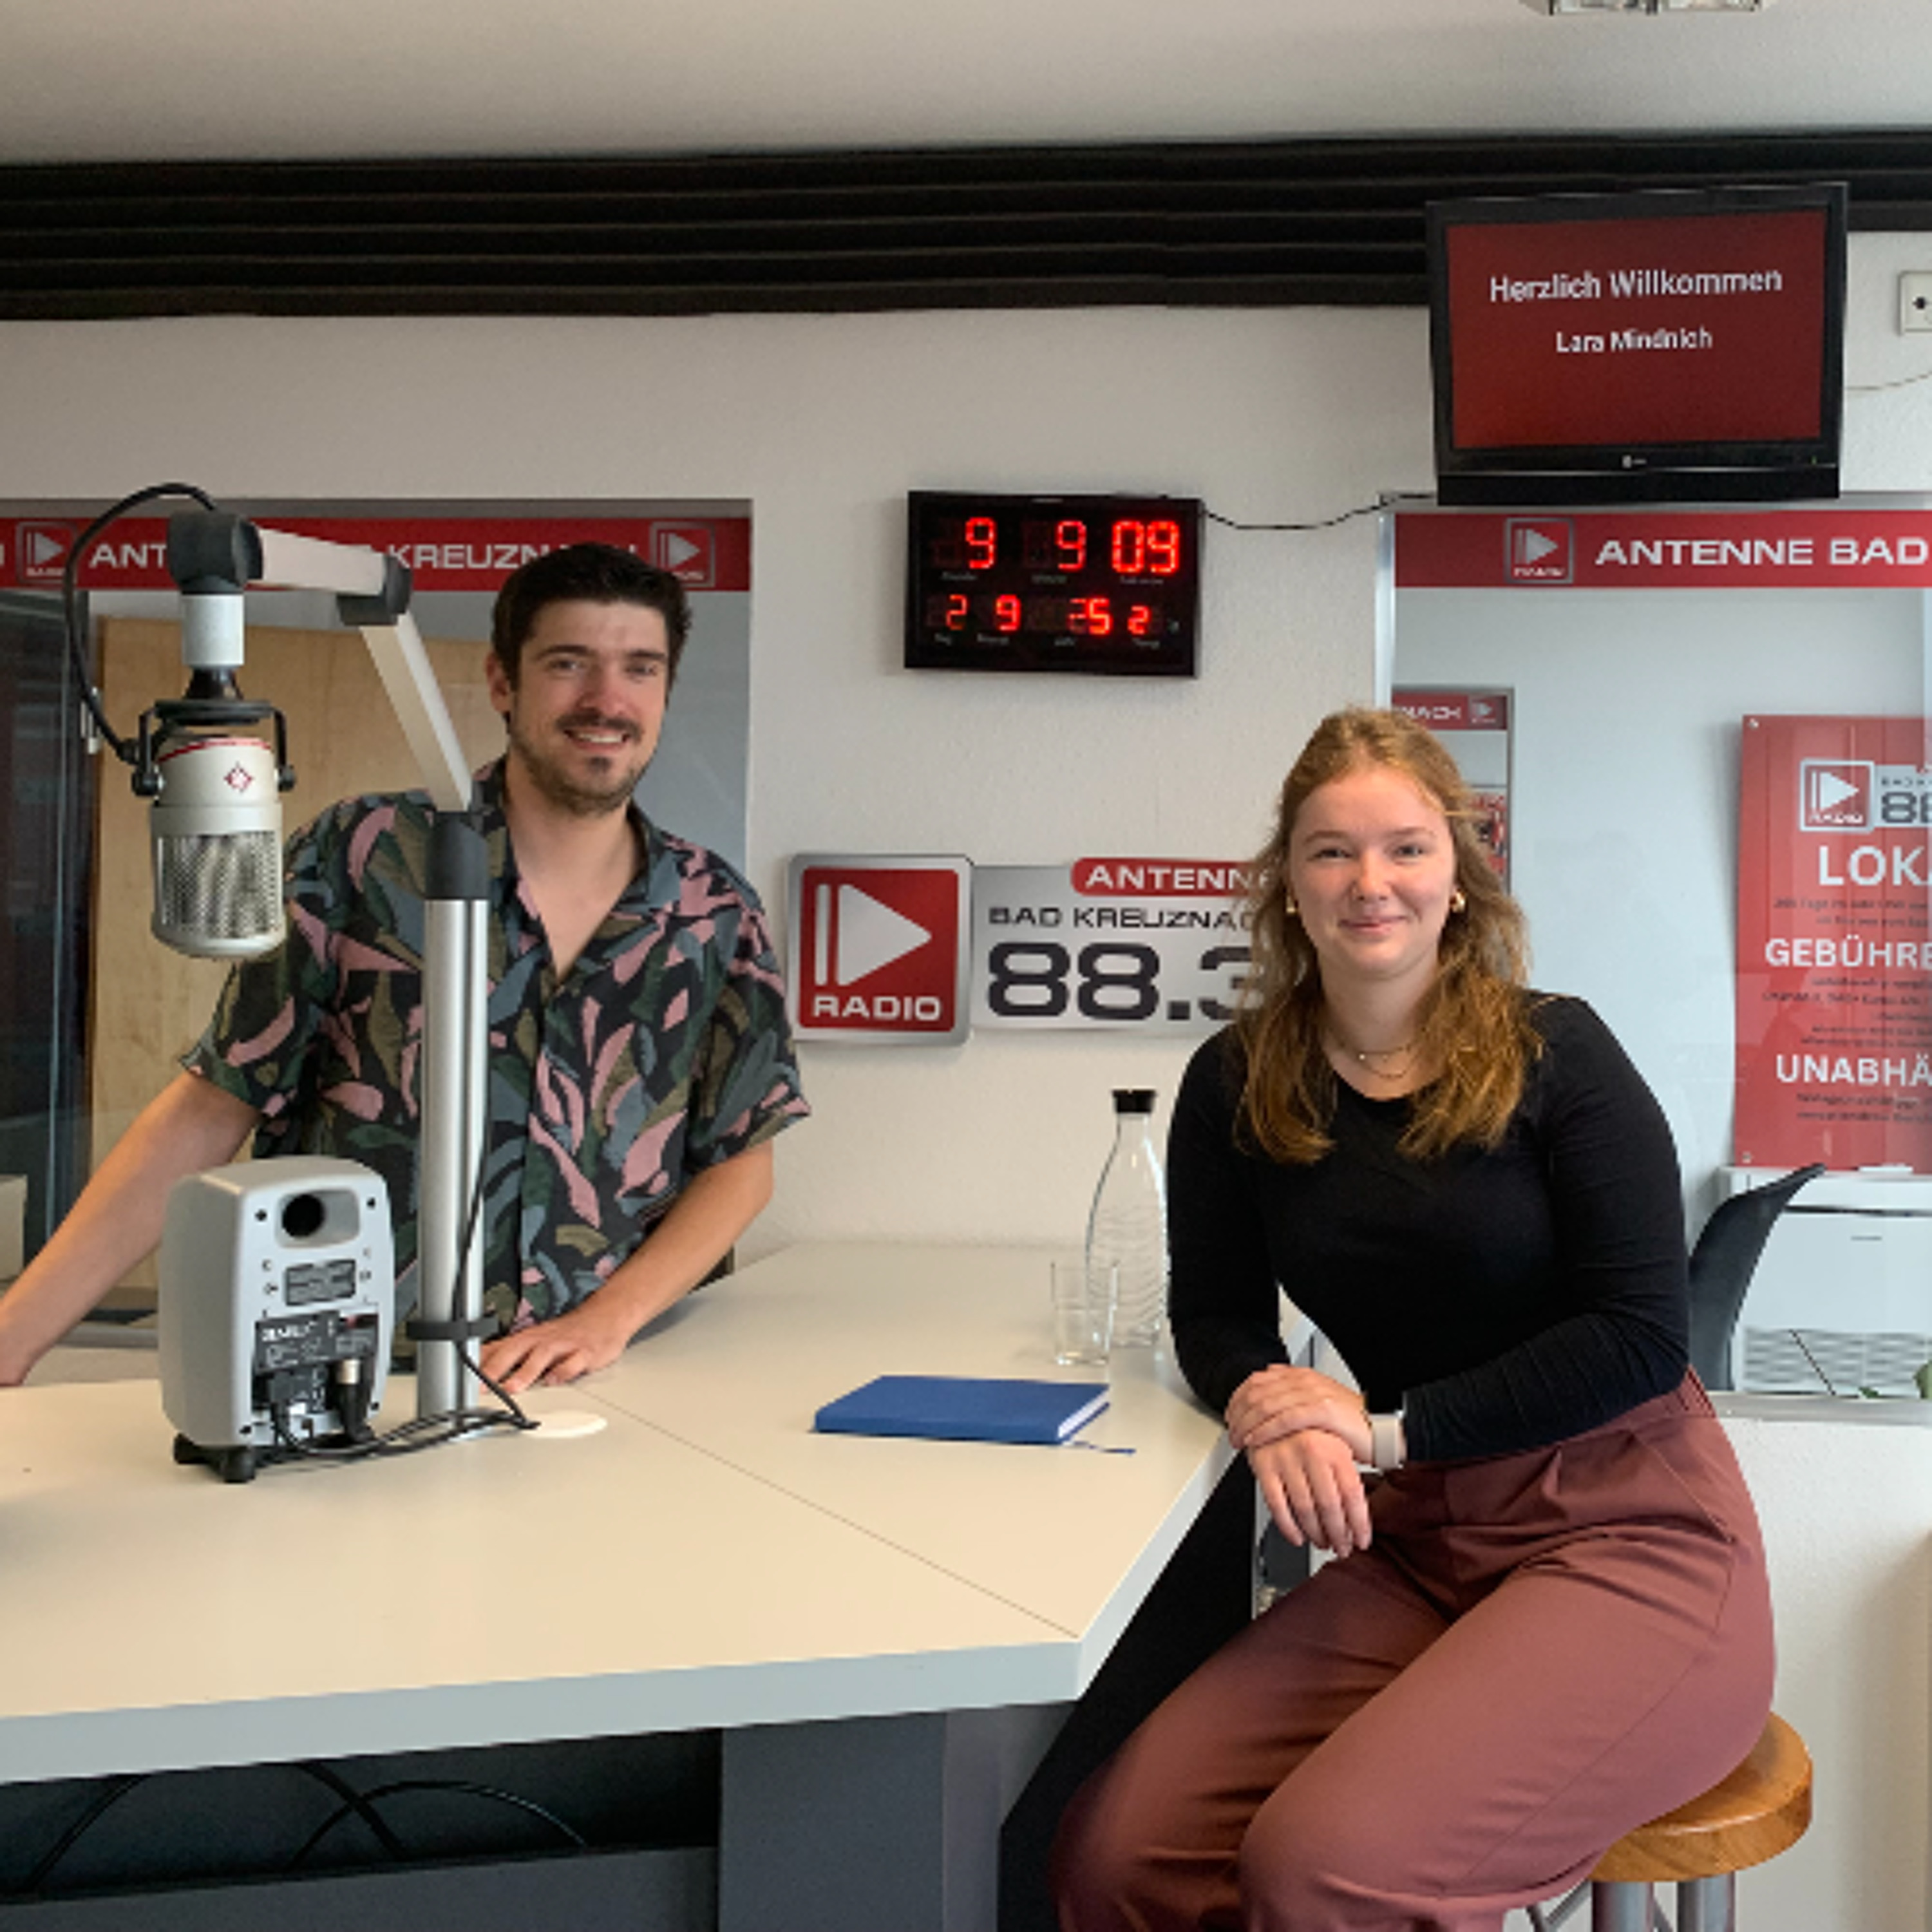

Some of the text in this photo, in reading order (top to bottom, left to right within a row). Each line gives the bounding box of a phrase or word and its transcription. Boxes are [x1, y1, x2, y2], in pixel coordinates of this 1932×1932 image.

[1490, 269, 1783, 302] Herzlich Willkommen
[1556, 327, 1712, 353] Lara Mindnich
[965, 516, 1180, 574] 9 9 09
[1595, 538, 1929, 565] ANTENNE BAD
[1818, 845, 1932, 887] LOK
[988, 906, 1253, 931] BAD KREUZNAC
[812, 994, 942, 1021] RADIO
